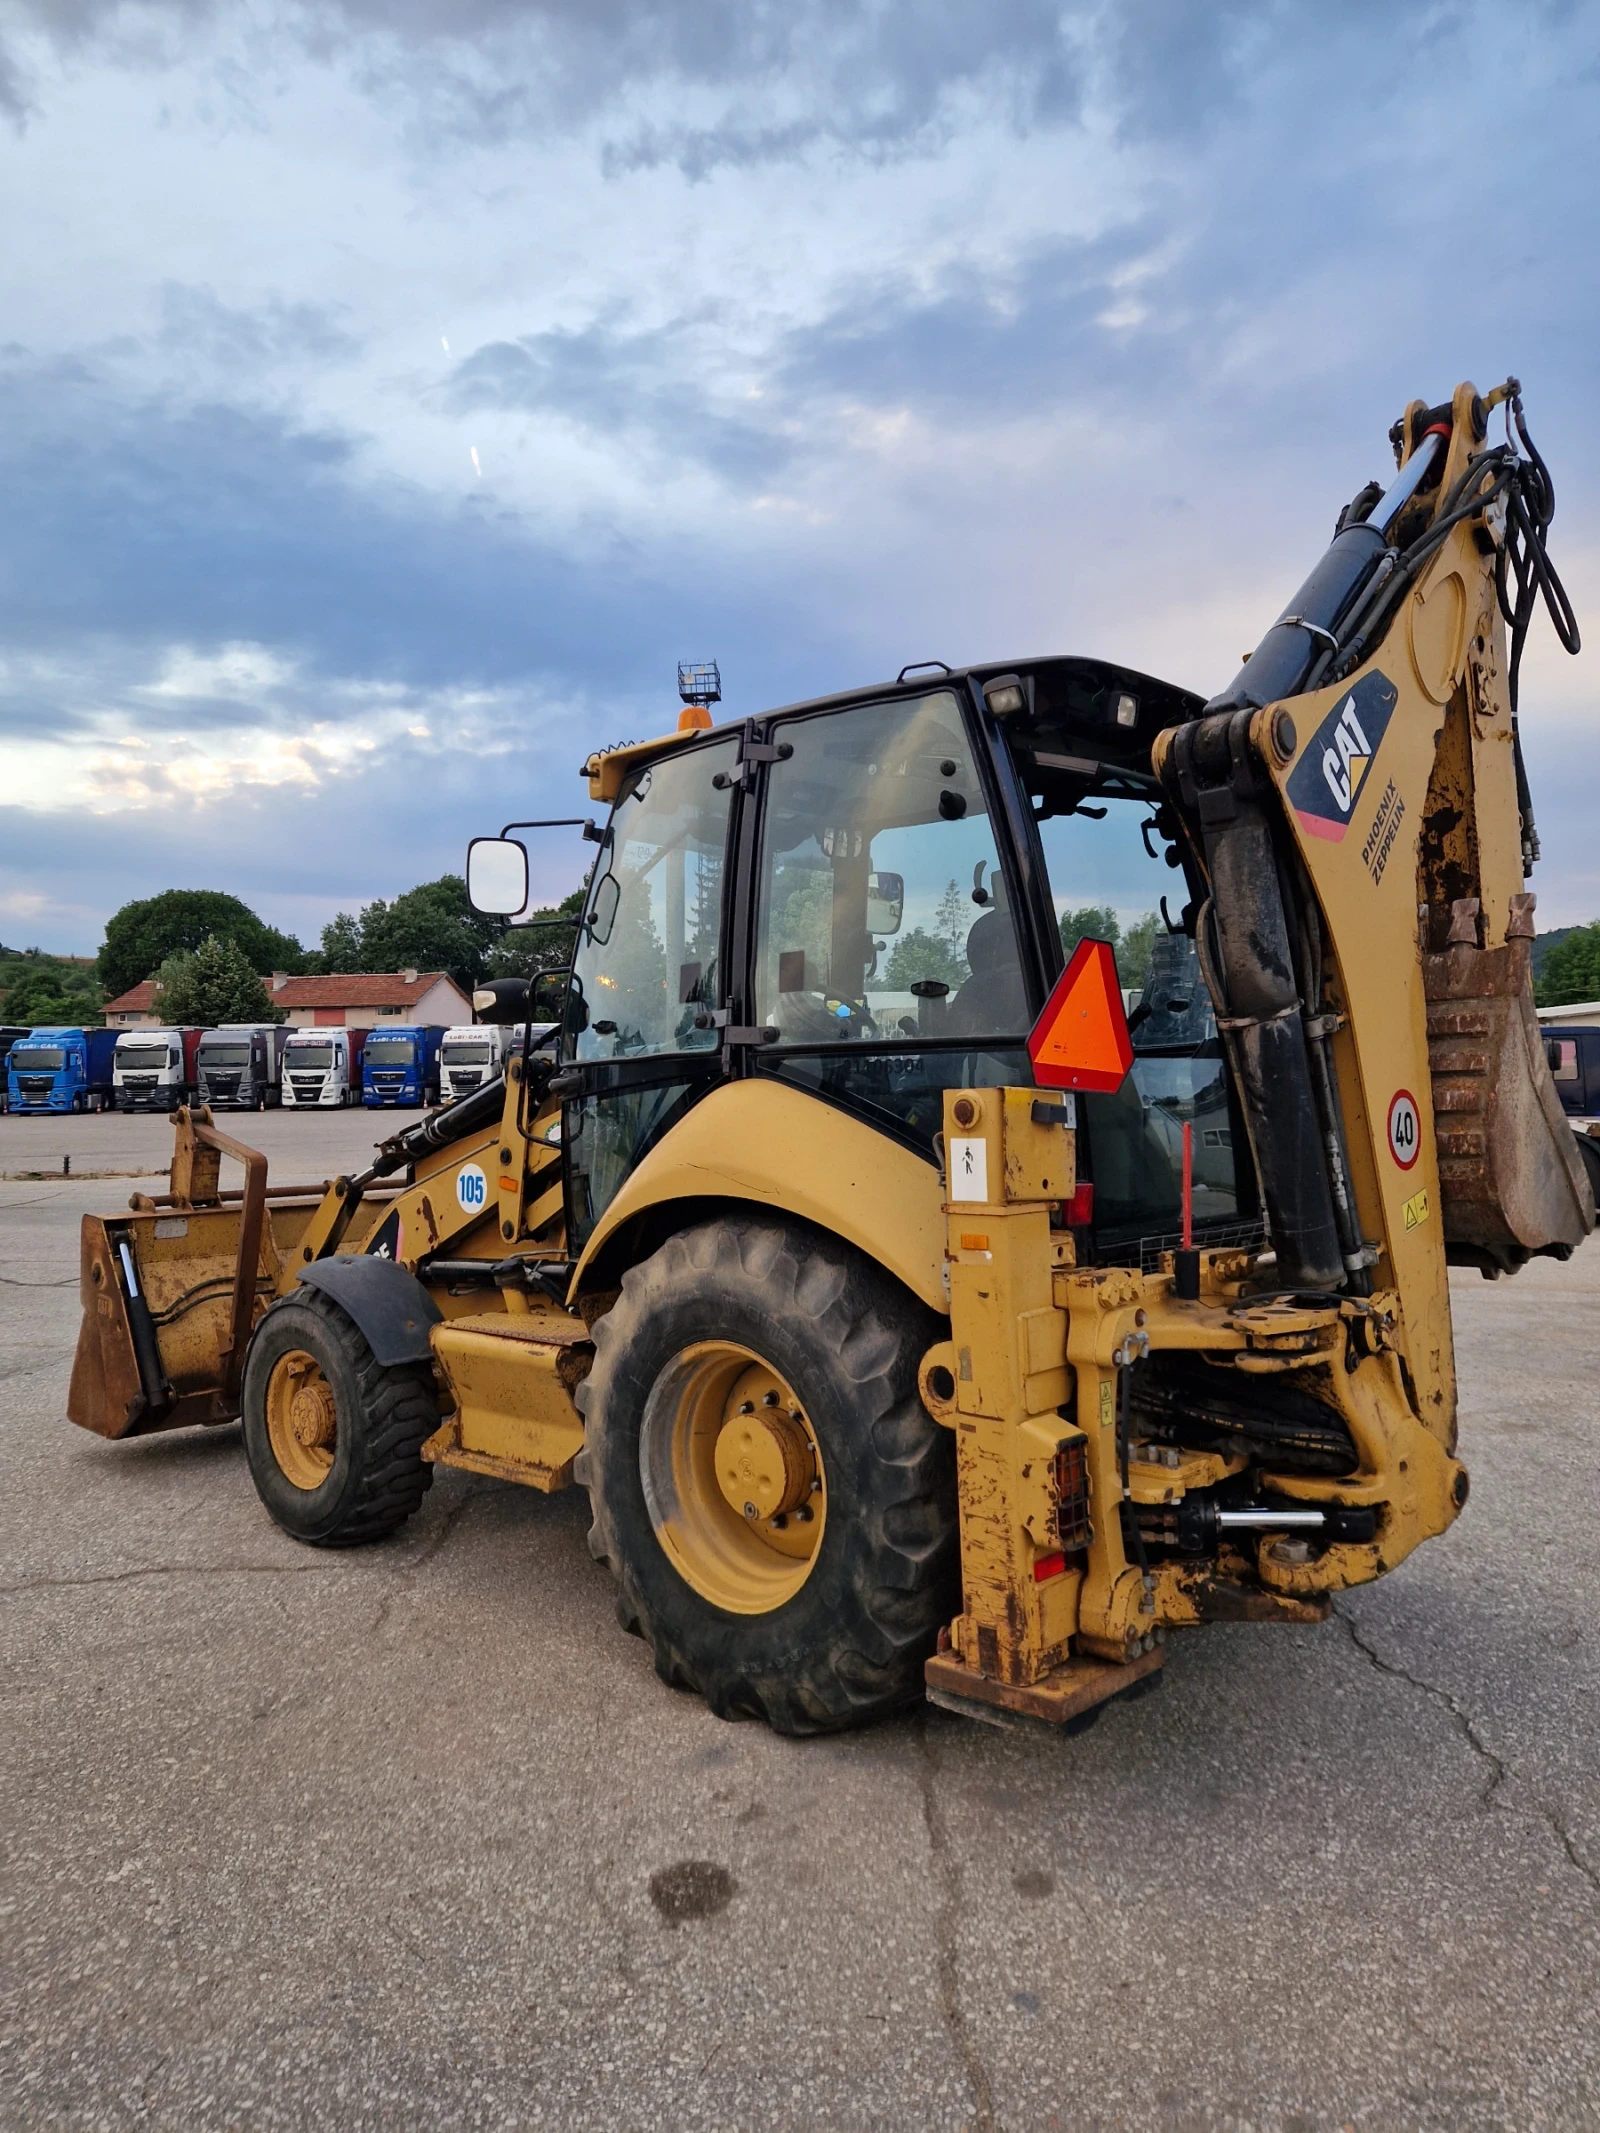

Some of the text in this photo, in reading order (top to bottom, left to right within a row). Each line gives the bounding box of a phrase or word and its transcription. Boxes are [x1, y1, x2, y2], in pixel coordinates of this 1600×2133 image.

[1323, 694, 1372, 813] CAT
[1361, 777, 1399, 867] PHOENIX
[1371, 797, 1406, 888] ZEPPELIN
[1395, 1111, 1414, 1148] 40
[459, 1174, 484, 1204] 105
